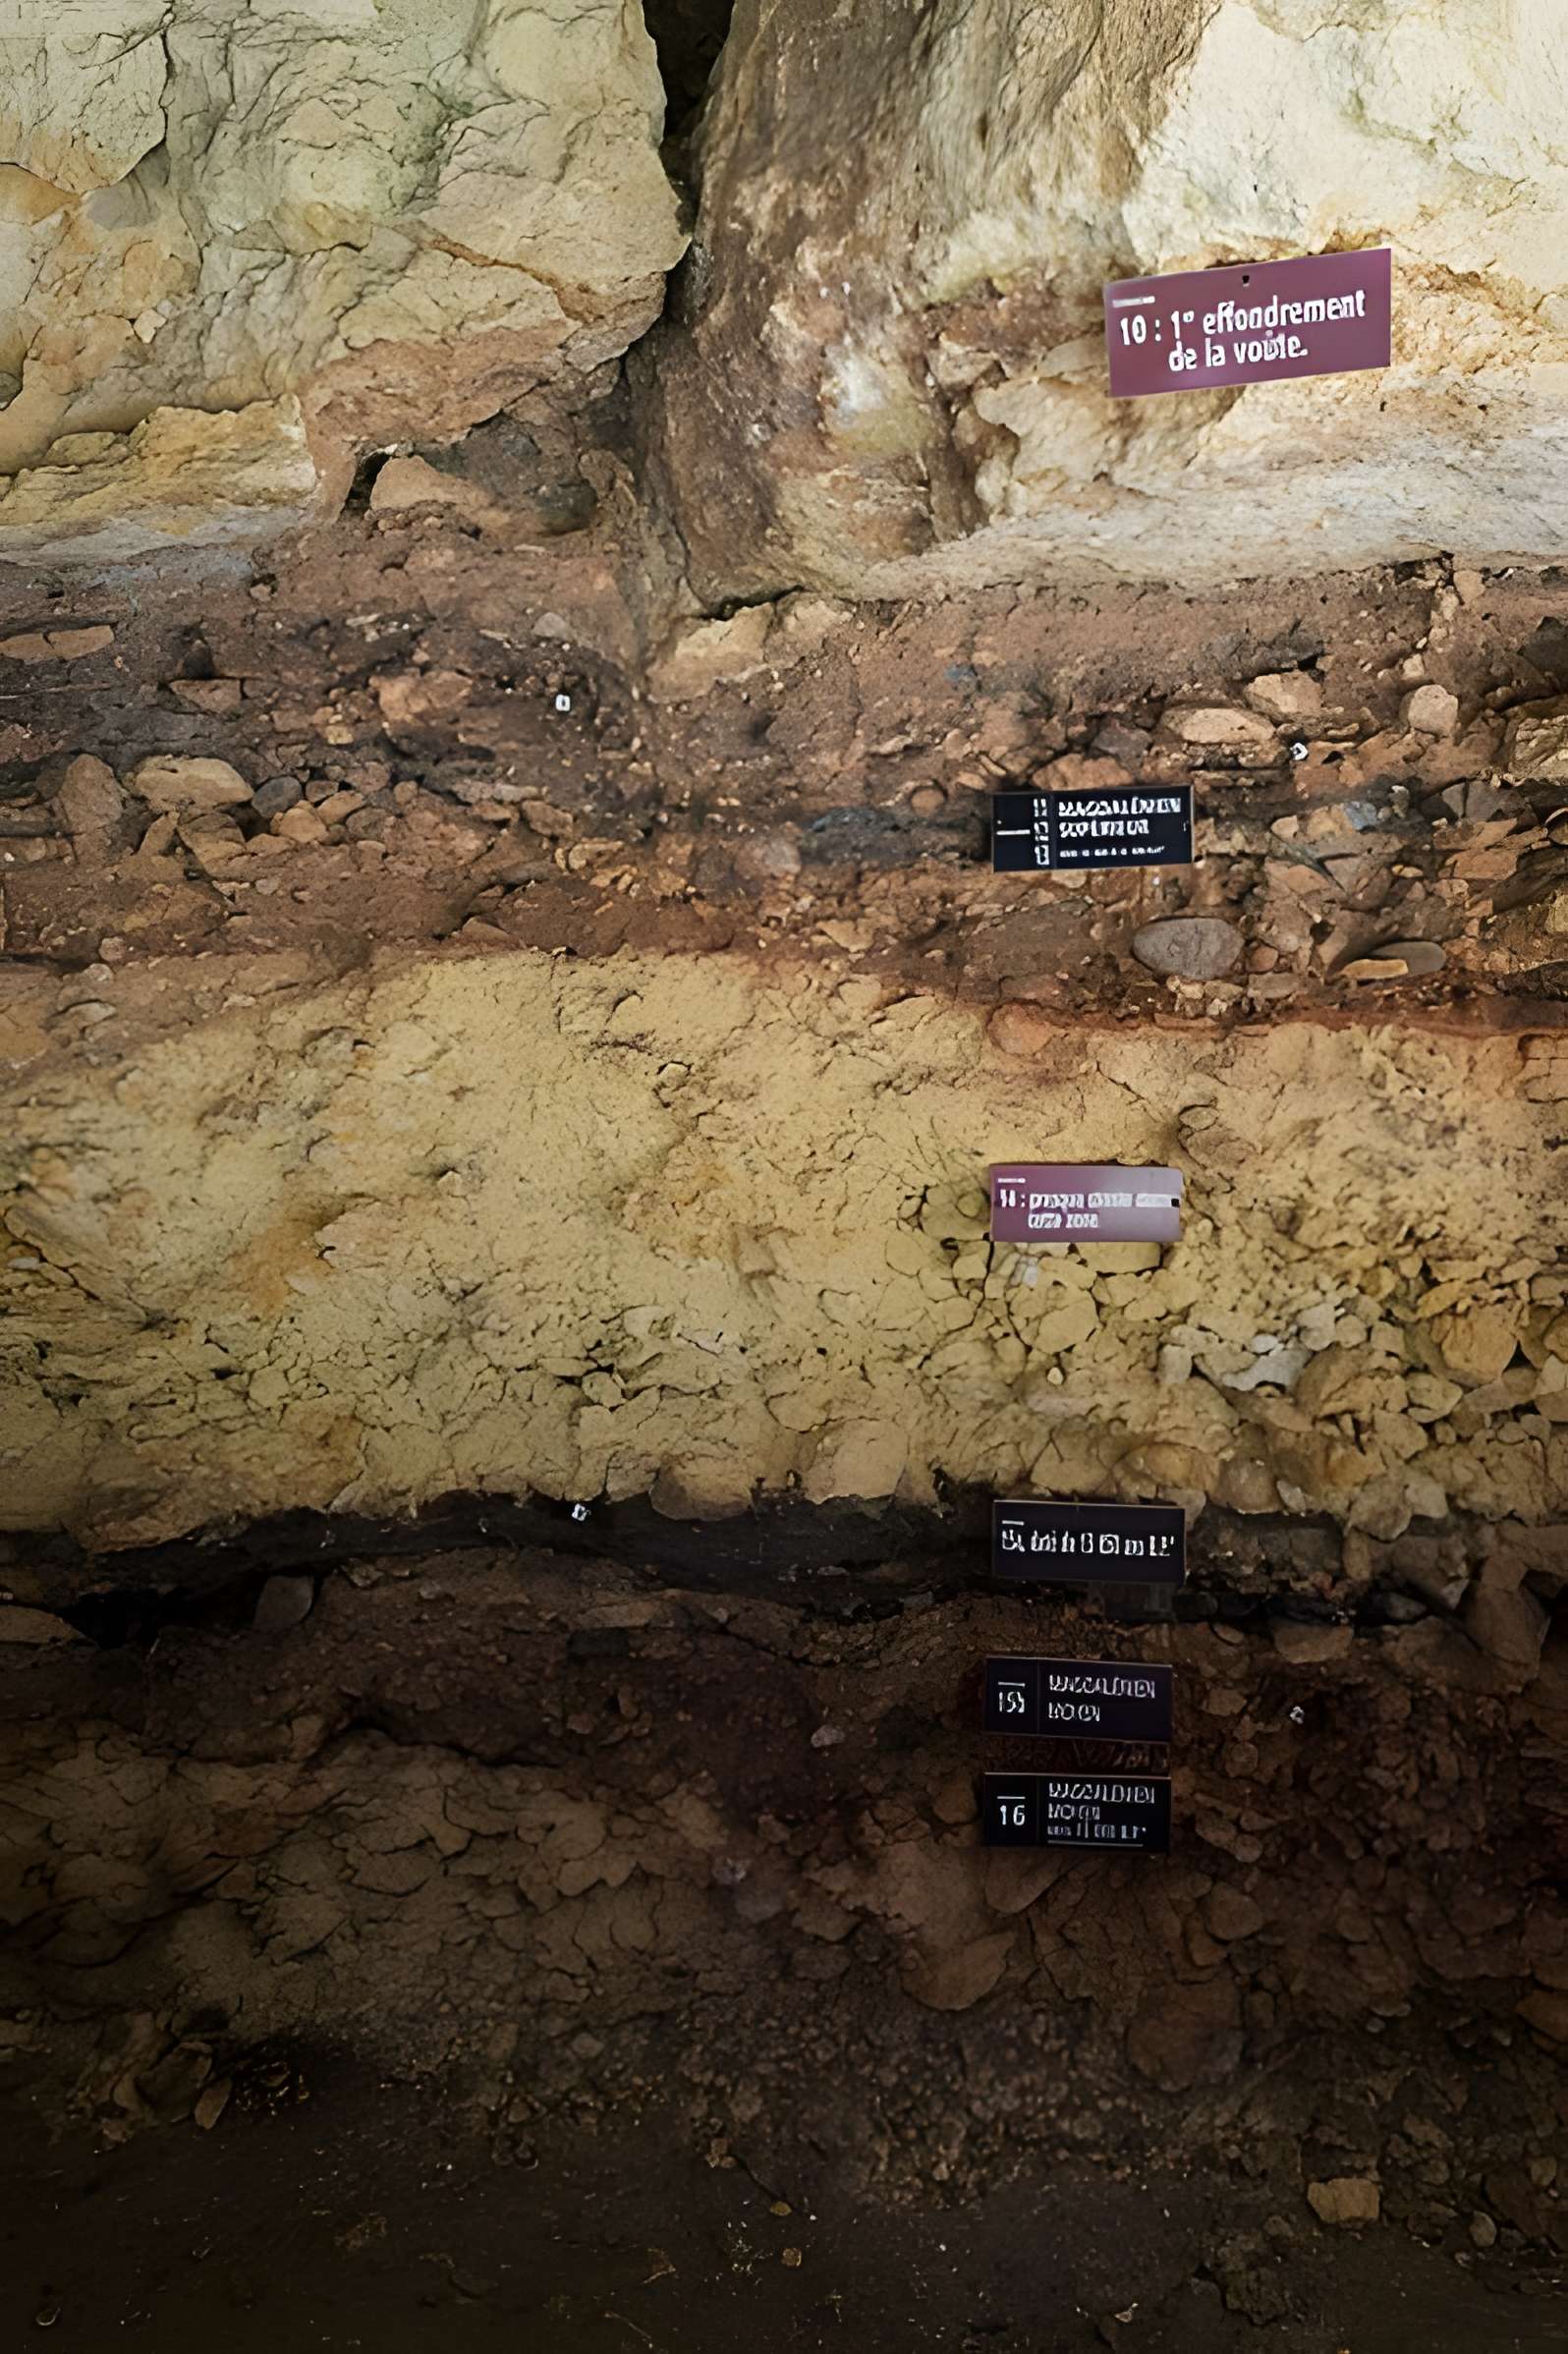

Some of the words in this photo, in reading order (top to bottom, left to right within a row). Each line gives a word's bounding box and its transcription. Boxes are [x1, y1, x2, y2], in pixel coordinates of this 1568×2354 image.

[1120, 314, 1147, 345] 10
[1203, 290, 1366, 335] effondrement
[1168, 341, 1198, 371] de
[1204, 338, 1226, 367] la
[999, 1805, 1026, 1825] 16
